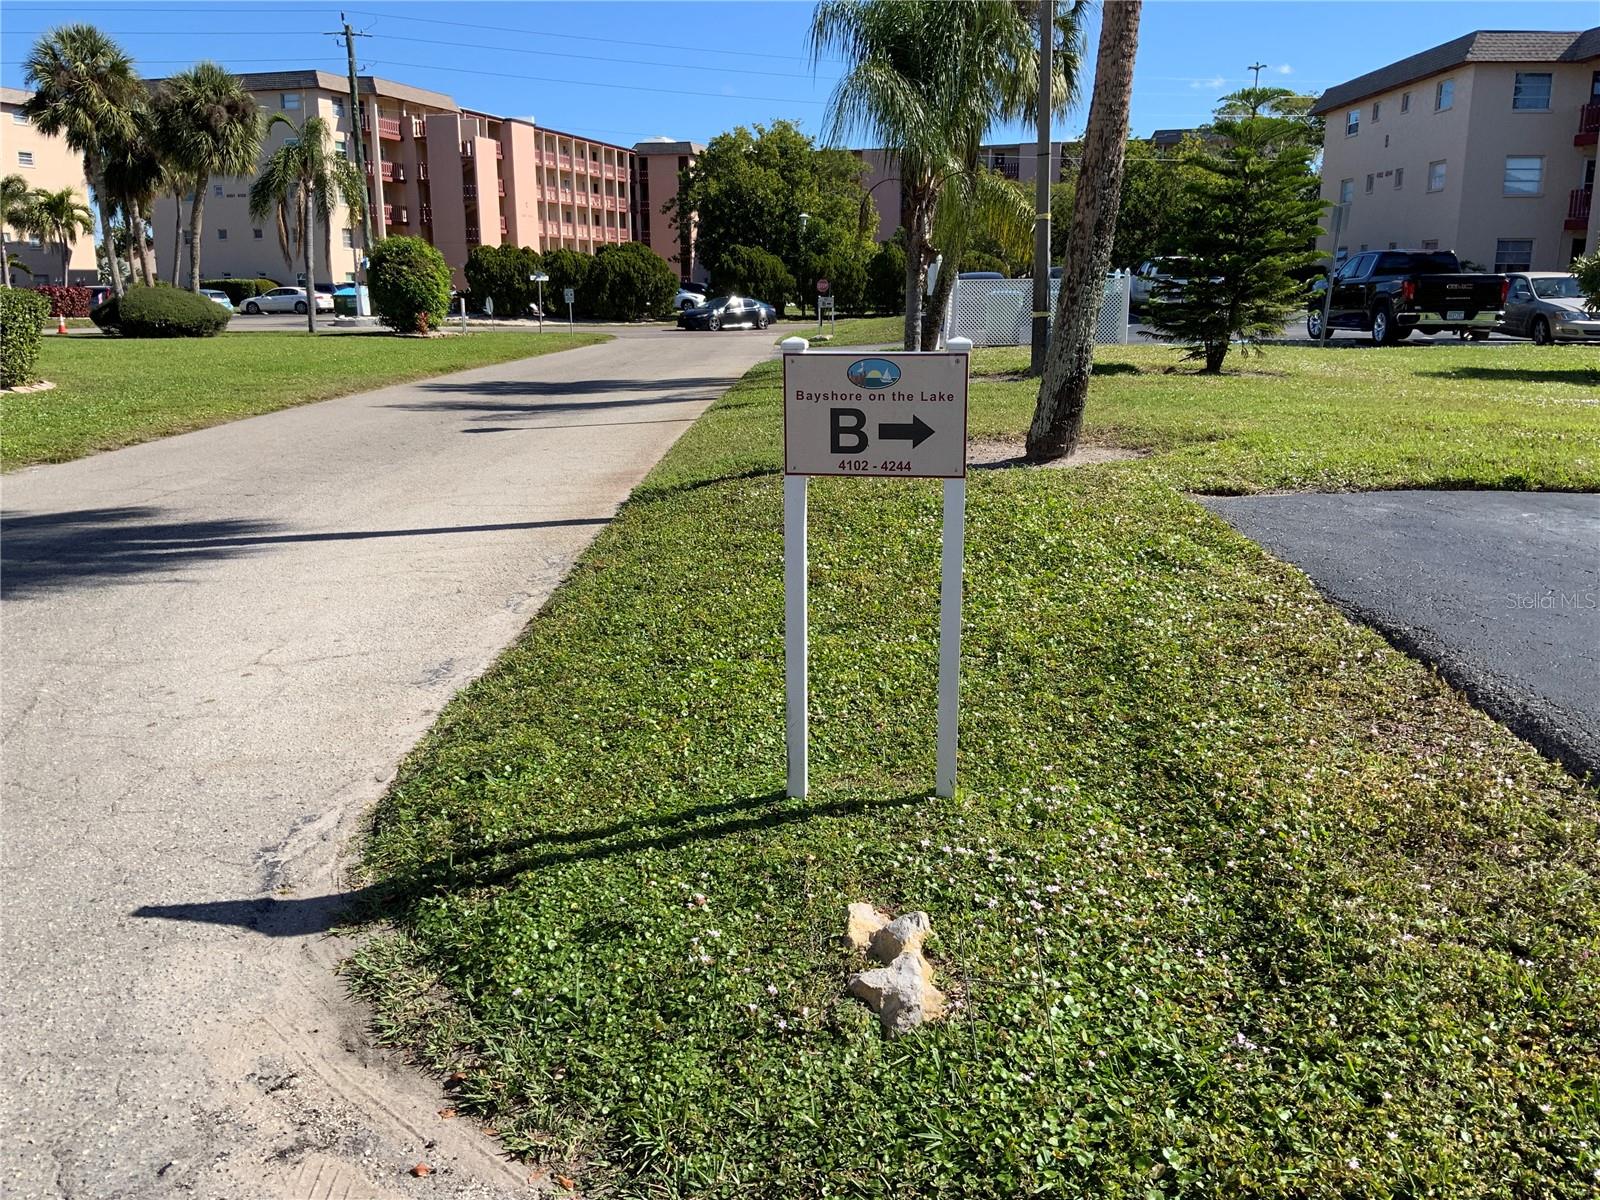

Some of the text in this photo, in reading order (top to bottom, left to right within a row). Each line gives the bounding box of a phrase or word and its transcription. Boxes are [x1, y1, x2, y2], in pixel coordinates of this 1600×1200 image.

[796, 390, 954, 403] Bayshore on the Lake
[830, 407, 869, 454] B
[838, 460, 869, 471] 4102
[880, 460, 912, 472] 4244
